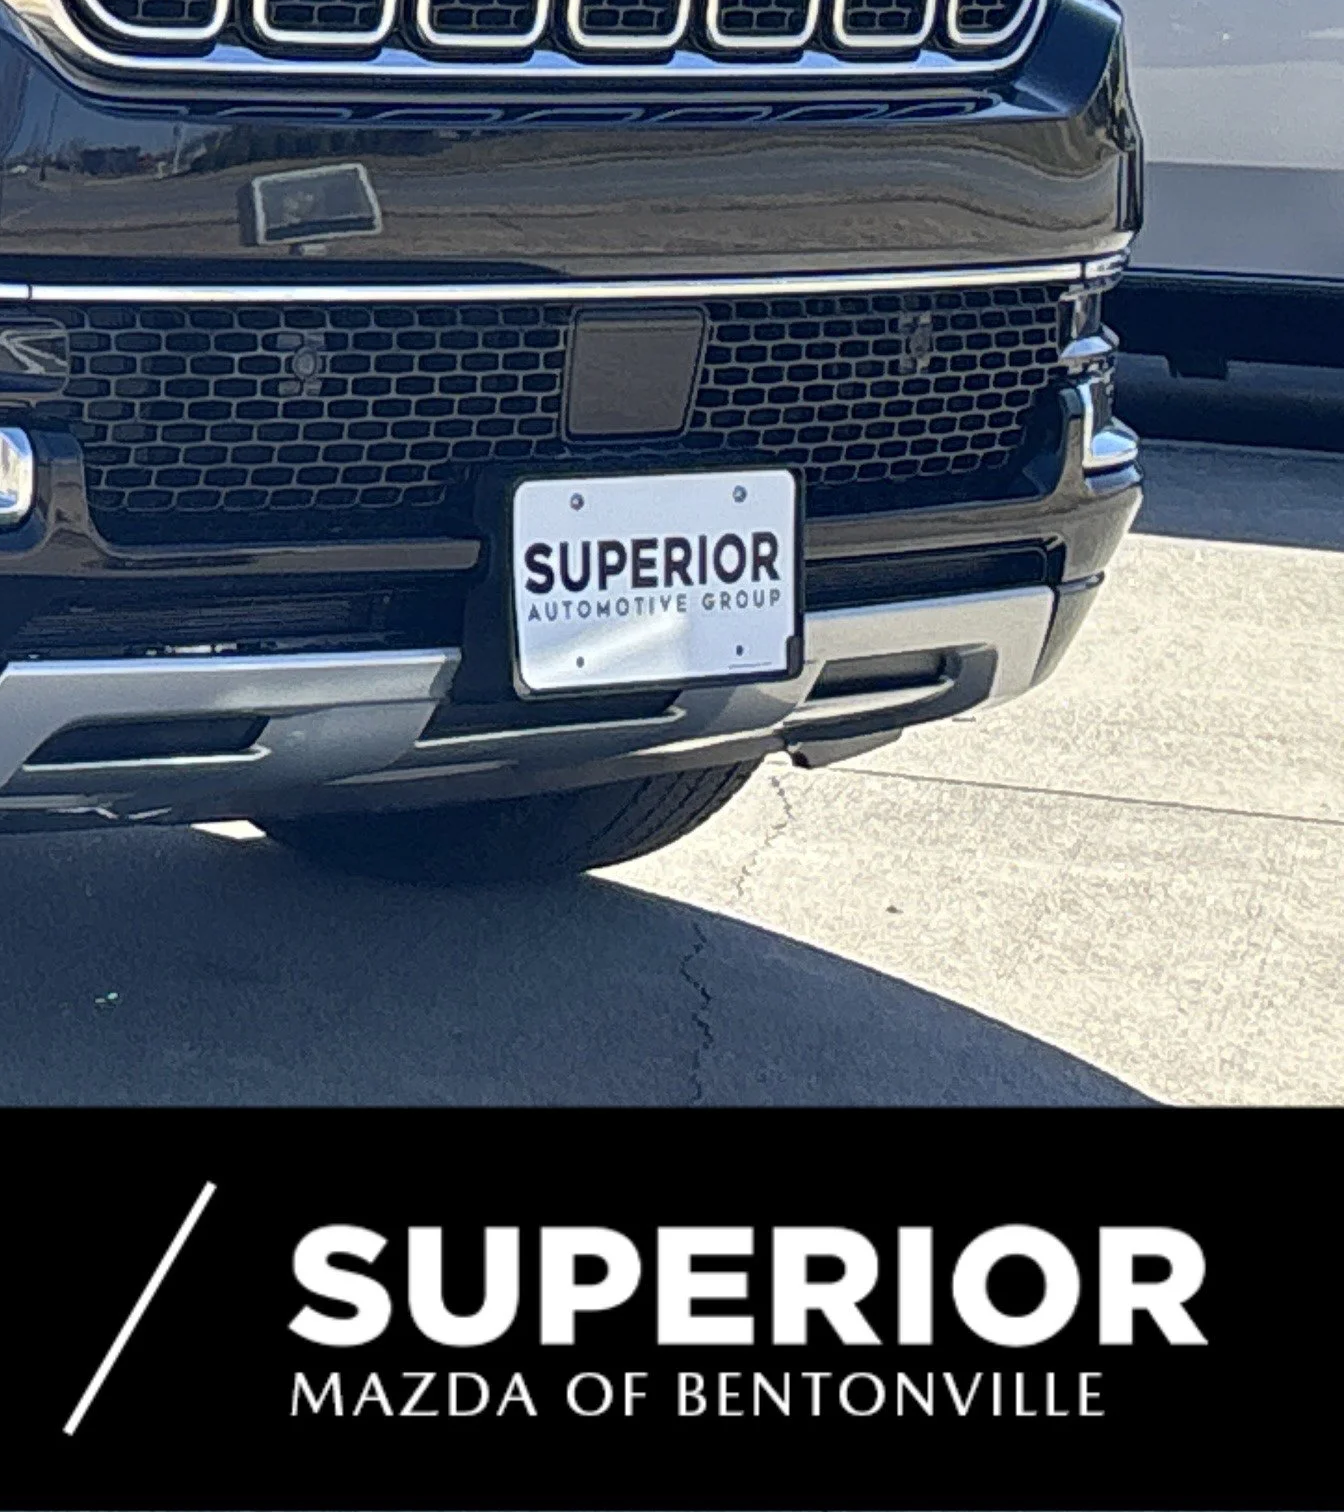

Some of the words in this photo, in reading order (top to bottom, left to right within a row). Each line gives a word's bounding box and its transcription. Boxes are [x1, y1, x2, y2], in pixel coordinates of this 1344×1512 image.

[524, 531, 781, 595] SUPERIOR
[527, 592, 688, 622] AUTOMOTIVE
[701, 588, 782, 612] GROUP
